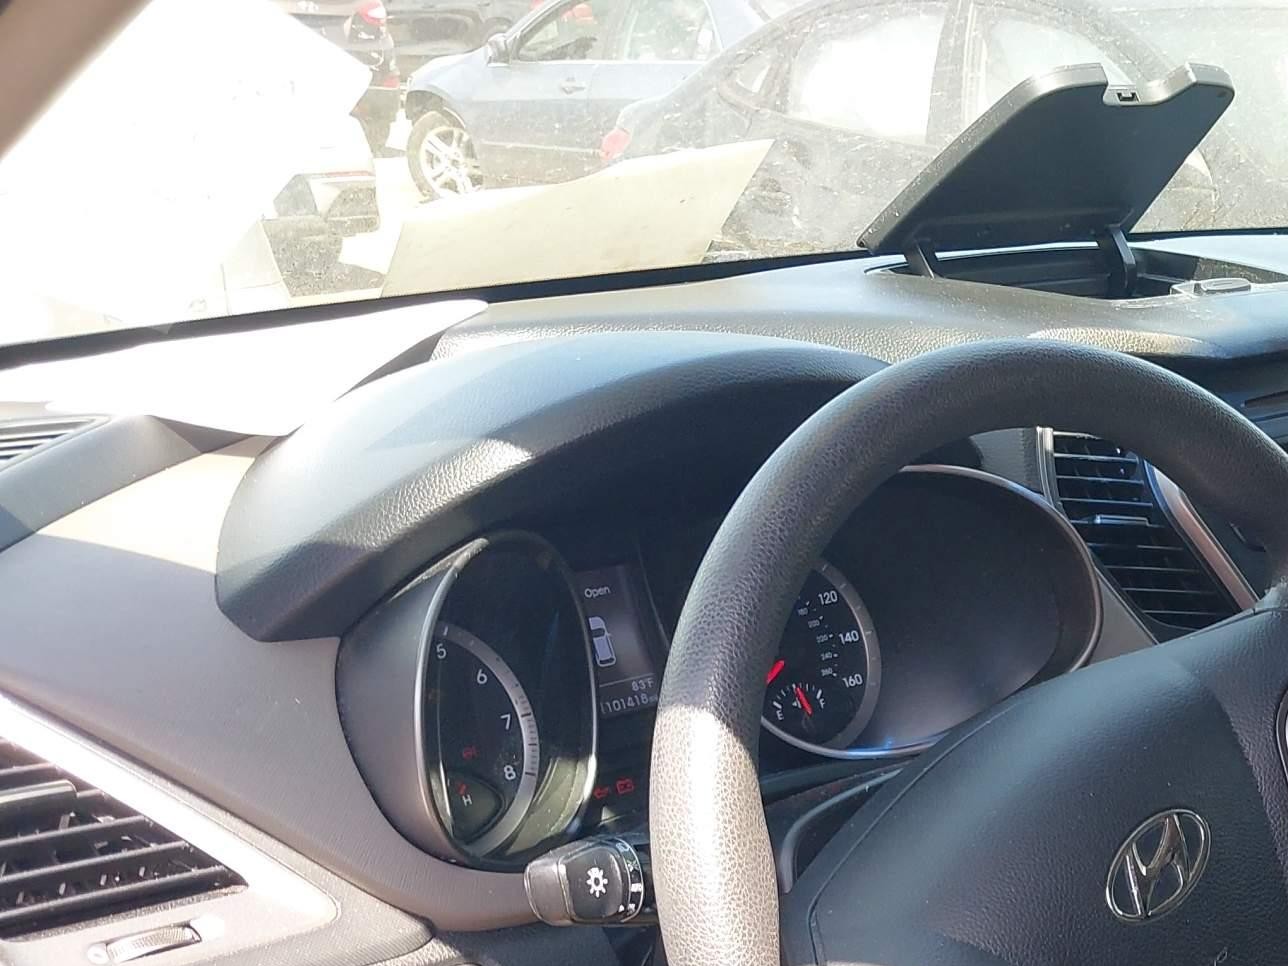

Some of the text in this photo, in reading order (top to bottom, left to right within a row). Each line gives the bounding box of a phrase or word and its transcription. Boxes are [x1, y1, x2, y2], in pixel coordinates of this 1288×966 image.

[584, 585, 611, 599] Open
[818, 590, 838, 606] 120
[838, 629, 860, 645] 140
[436, 643, 447, 660] 5
[476, 668, 488, 685] 6
[842, 673, 863, 689] 160
[820, 699, 826, 708] F
[500, 713, 511, 731] 7
[776, 709, 784, 721] E
[503, 764, 516, 781] 8
[462, 794, 473, 807] H
